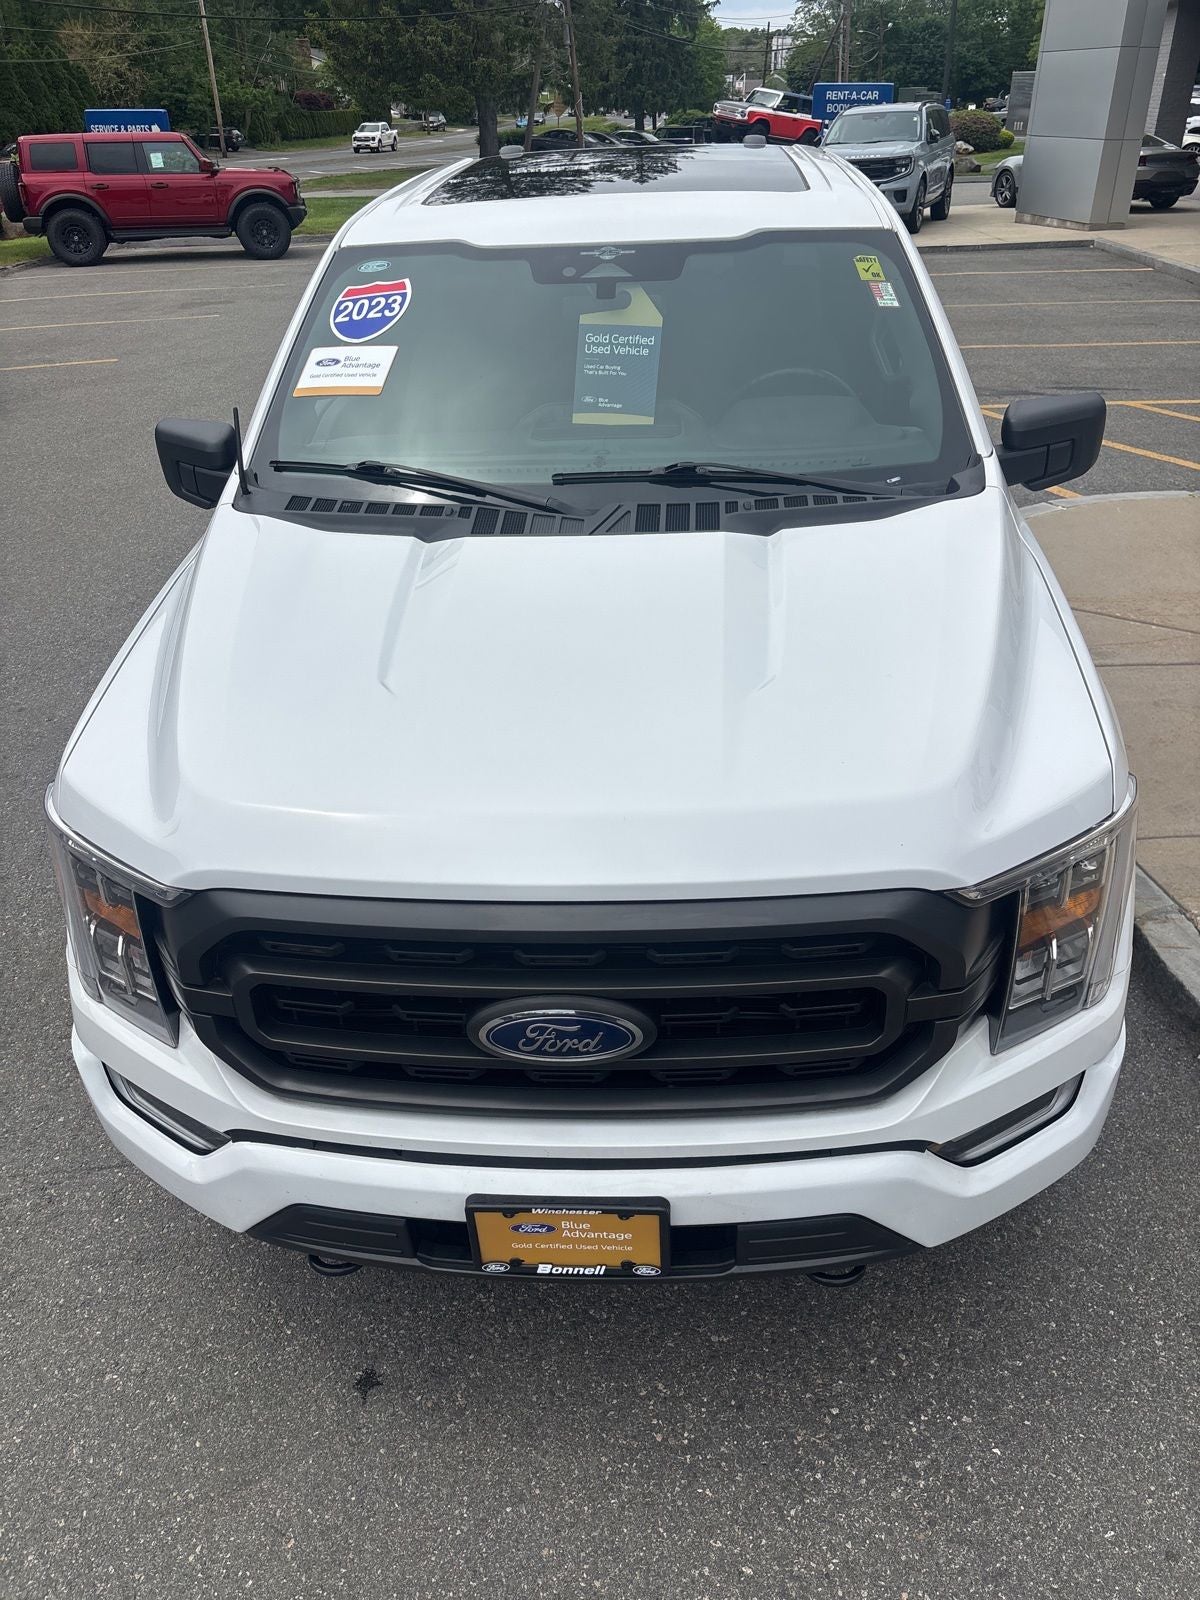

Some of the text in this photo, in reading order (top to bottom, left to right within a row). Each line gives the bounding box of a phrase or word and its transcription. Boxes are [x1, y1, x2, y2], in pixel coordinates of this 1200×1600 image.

[826, 91, 879, 100] RENT-A-CAR
[91, 124, 150, 132] SERVICE & PARTS
[334, 295, 402, 323] 2023
[585, 333, 655, 345] Gold Certified
[584, 344, 649, 356] Used Vehicle
[518, 1023, 604, 1052] Ford
[518, 1224, 548, 1233] Ford
[561, 1220, 591, 1230] Blue
[562, 1229, 633, 1240] Advantage
[535, 1242, 573, 1250] Certified
[537, 1264, 606, 1275] Bonnell
